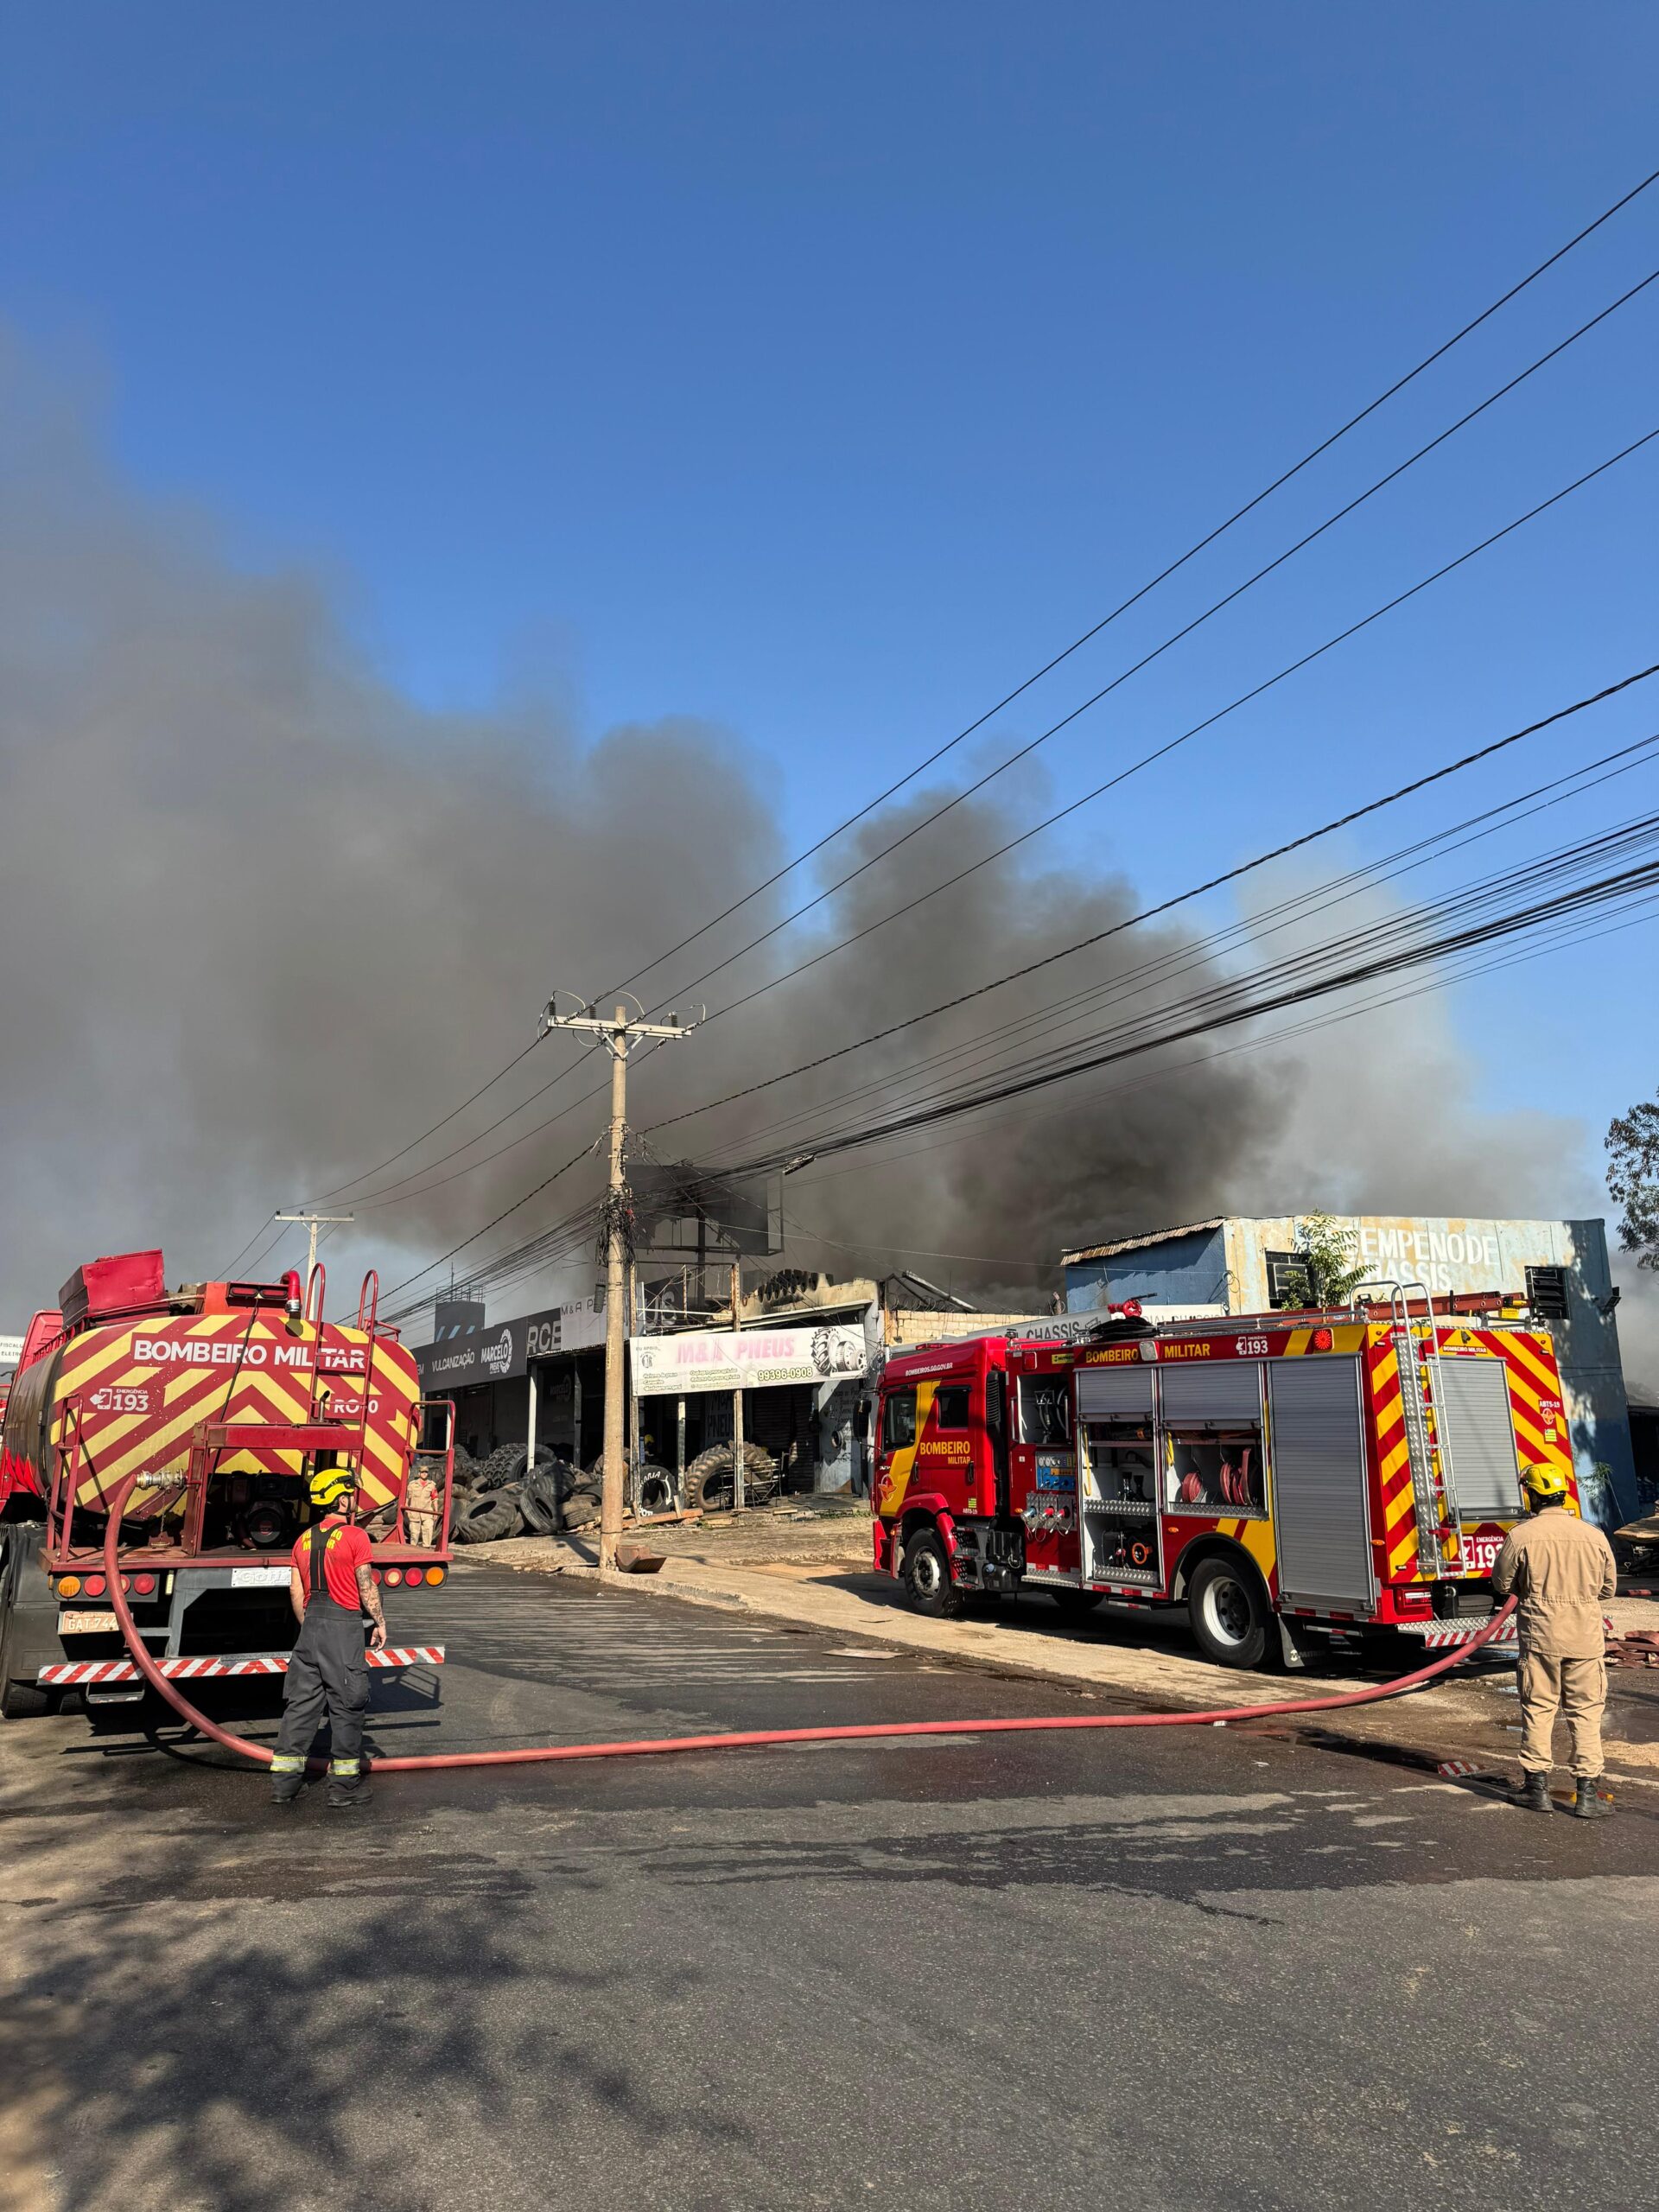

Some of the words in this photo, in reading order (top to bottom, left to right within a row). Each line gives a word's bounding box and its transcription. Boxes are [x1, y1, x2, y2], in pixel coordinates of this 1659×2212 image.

[134, 1339, 268, 1365] BOMBEIRO
[480, 1343, 509, 1363] MARCELO
[735, 1338, 795, 1360] PNEUS
[1085, 1348, 1139, 1363] BOMBEIRO
[1164, 1343, 1211, 1358] MILITAR
[1247, 1339, 1268, 1355] 193
[758, 1367, 813, 1382] 99396-0908
[112, 1395, 149, 1412] 193
[920, 1440, 970, 1455] BOMBEIRO
[948, 1456, 970, 1465] MILITAR
